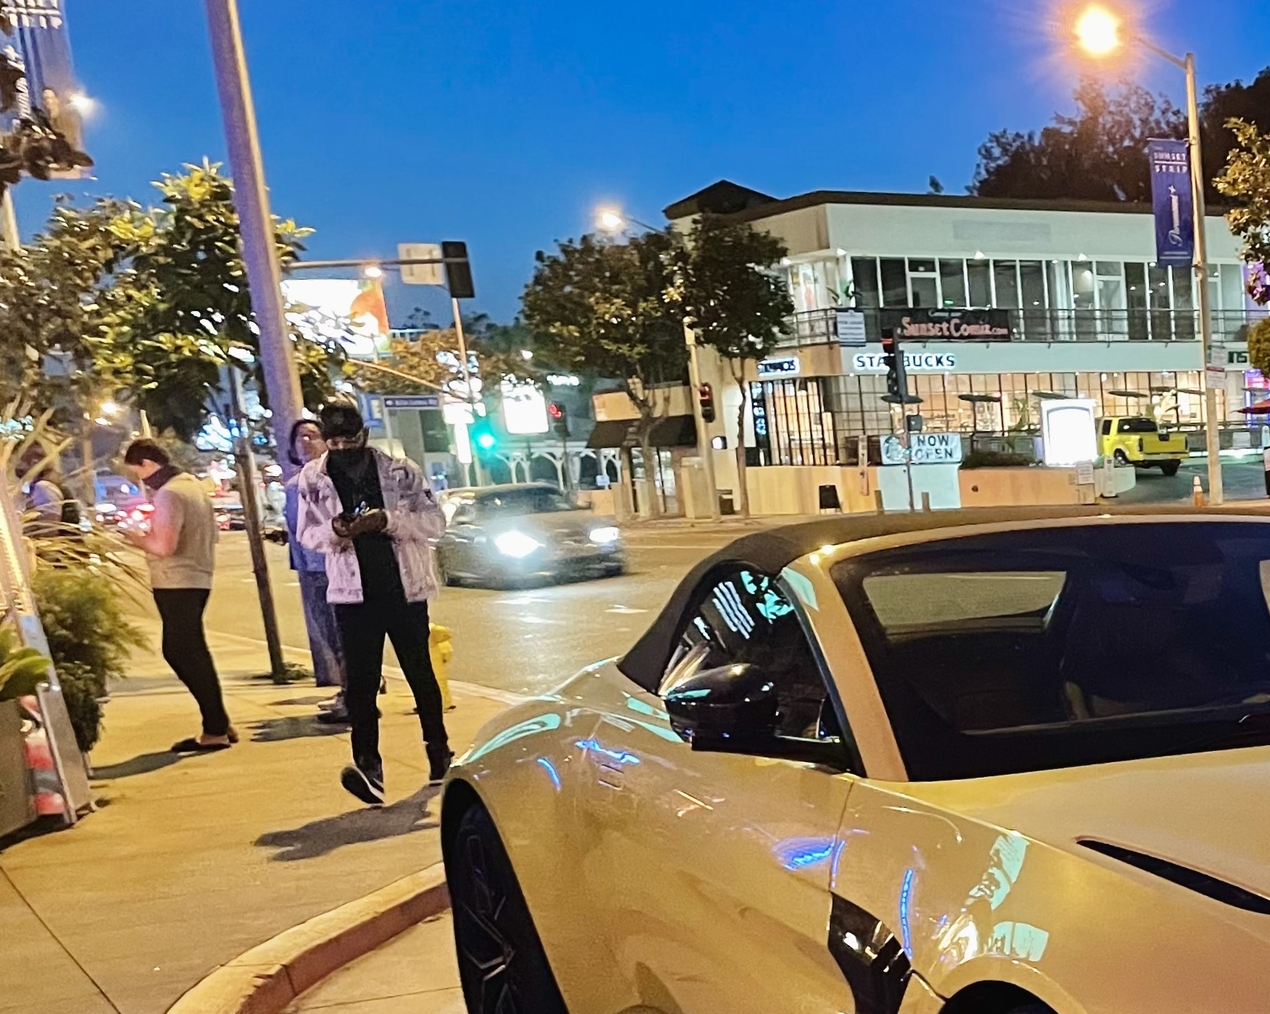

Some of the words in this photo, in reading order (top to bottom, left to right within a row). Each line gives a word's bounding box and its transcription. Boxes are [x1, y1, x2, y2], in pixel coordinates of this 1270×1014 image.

[1154, 164, 1188, 173] STRIP
[855, 354, 956, 368] STABUCKS
[917, 435, 949, 447] NOW
[914, 448, 953, 460] OPEN
